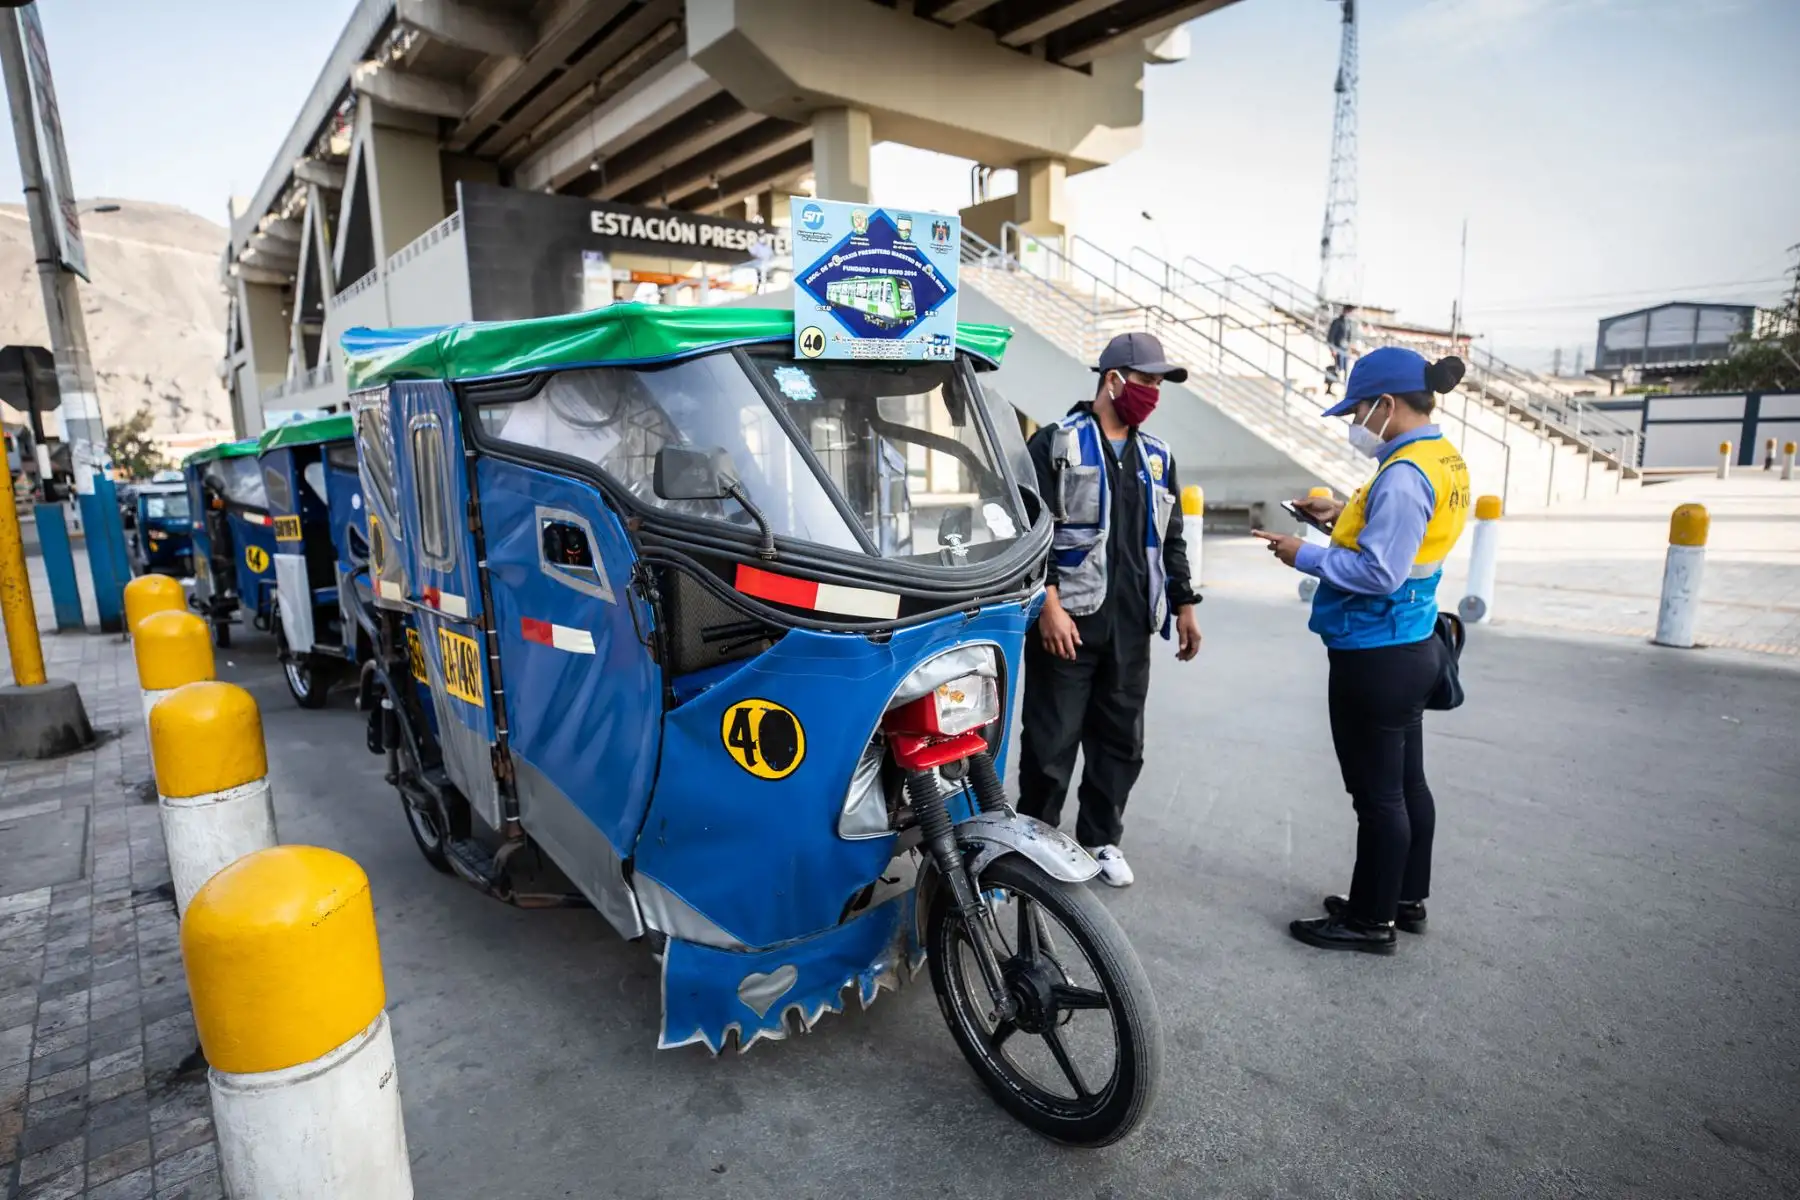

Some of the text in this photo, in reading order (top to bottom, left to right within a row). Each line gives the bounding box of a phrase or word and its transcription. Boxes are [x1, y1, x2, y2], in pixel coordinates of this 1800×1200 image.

[802, 210, 824, 223] SIT
[590, 210, 792, 256] ESTACIÓN PRESBTE
[891, 250, 916, 264] MAESTRO
[915, 261, 922, 269] DE
[842, 265, 871, 273] FUNDADO
